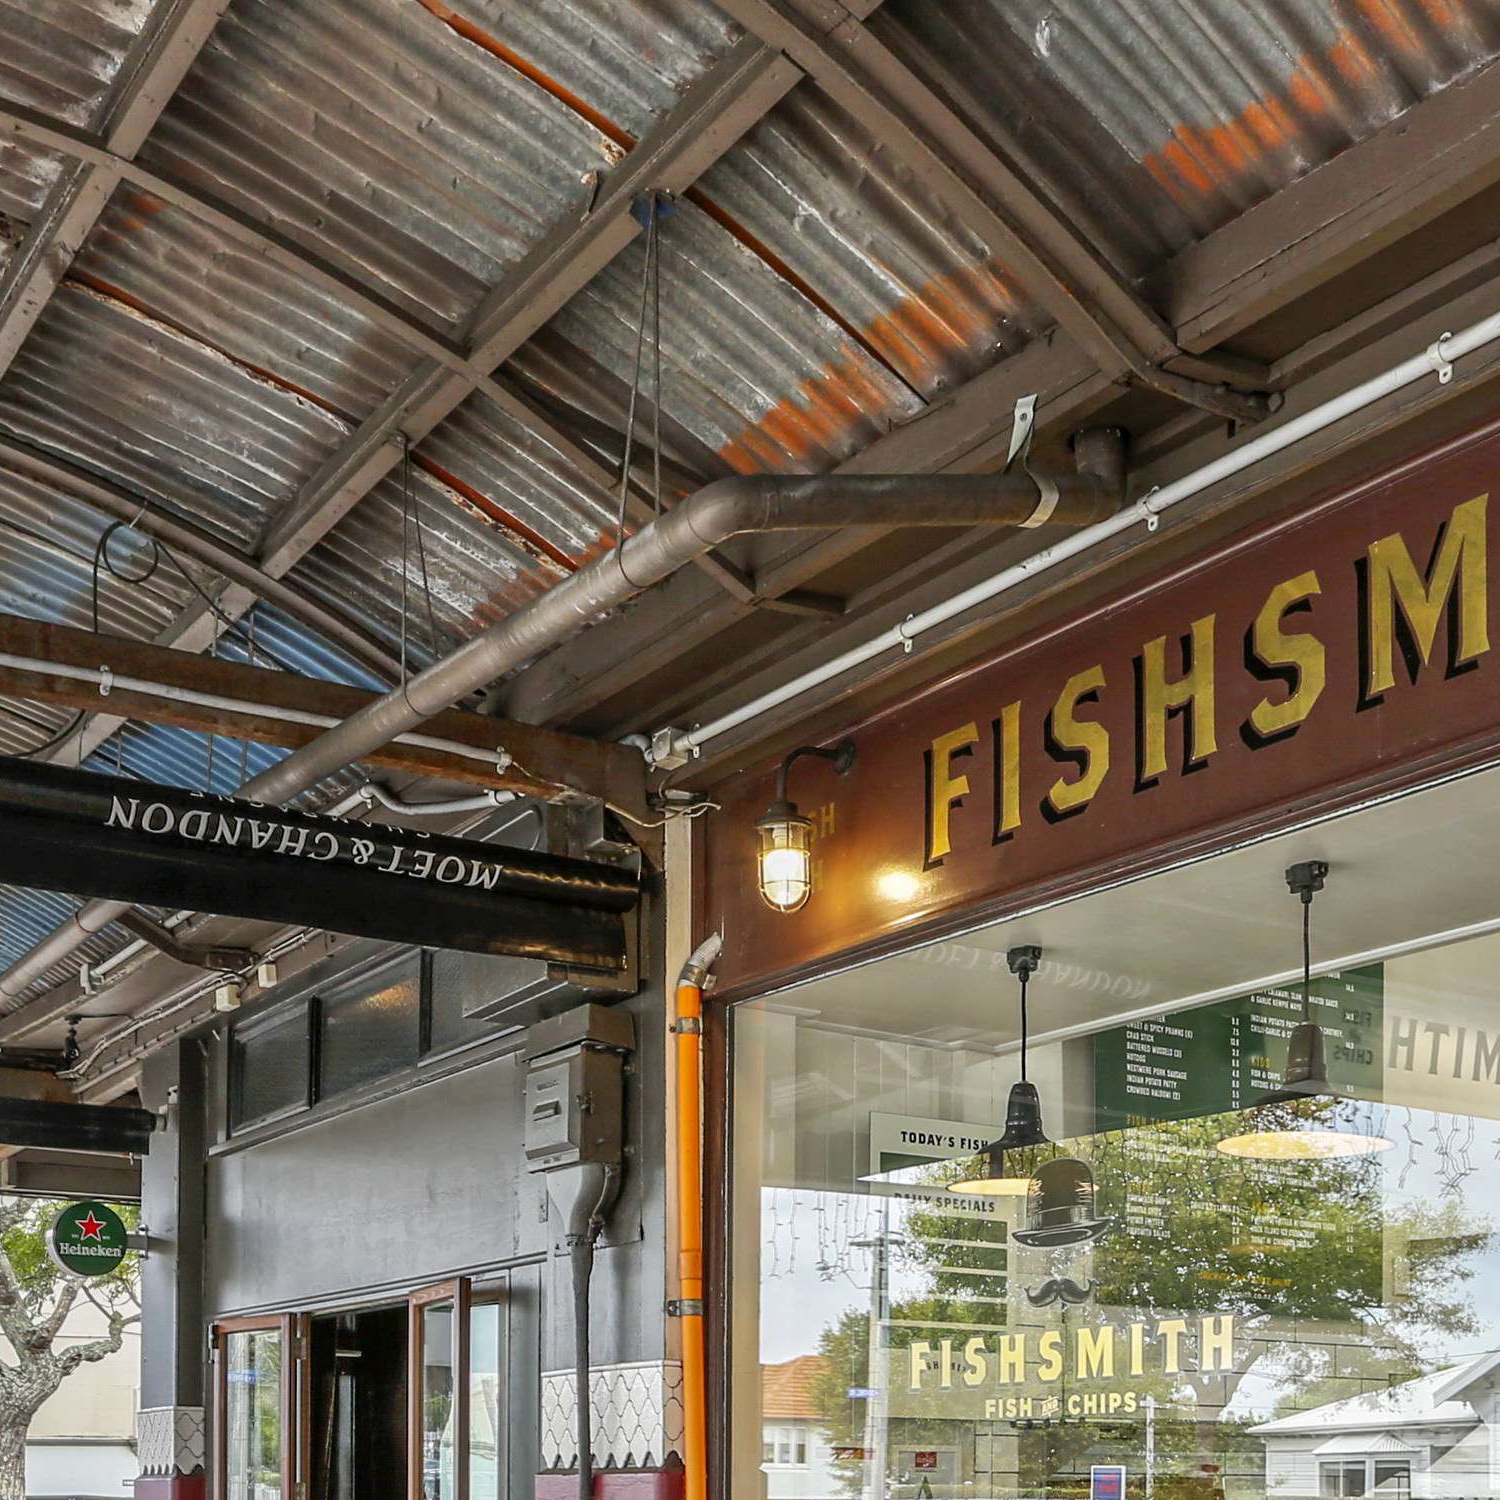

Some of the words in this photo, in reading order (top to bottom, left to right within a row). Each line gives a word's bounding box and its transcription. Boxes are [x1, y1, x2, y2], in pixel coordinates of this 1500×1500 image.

[104, 795, 339, 861] CHANDON
[350, 837, 375, 865] &
[379, 845, 502, 890] MOET
[901, 1131, 955, 1148] TODAY'S
[960, 1137, 989, 1151] FISH
[935, 1196, 996, 1213] SPECIALS
[60, 1242, 122, 1257] Heineken
[908, 1314, 1236, 1390] FISHSMITH
[985, 1398, 1033, 1419] FISH
[1067, 1393, 1136, 1416] CHIPS
